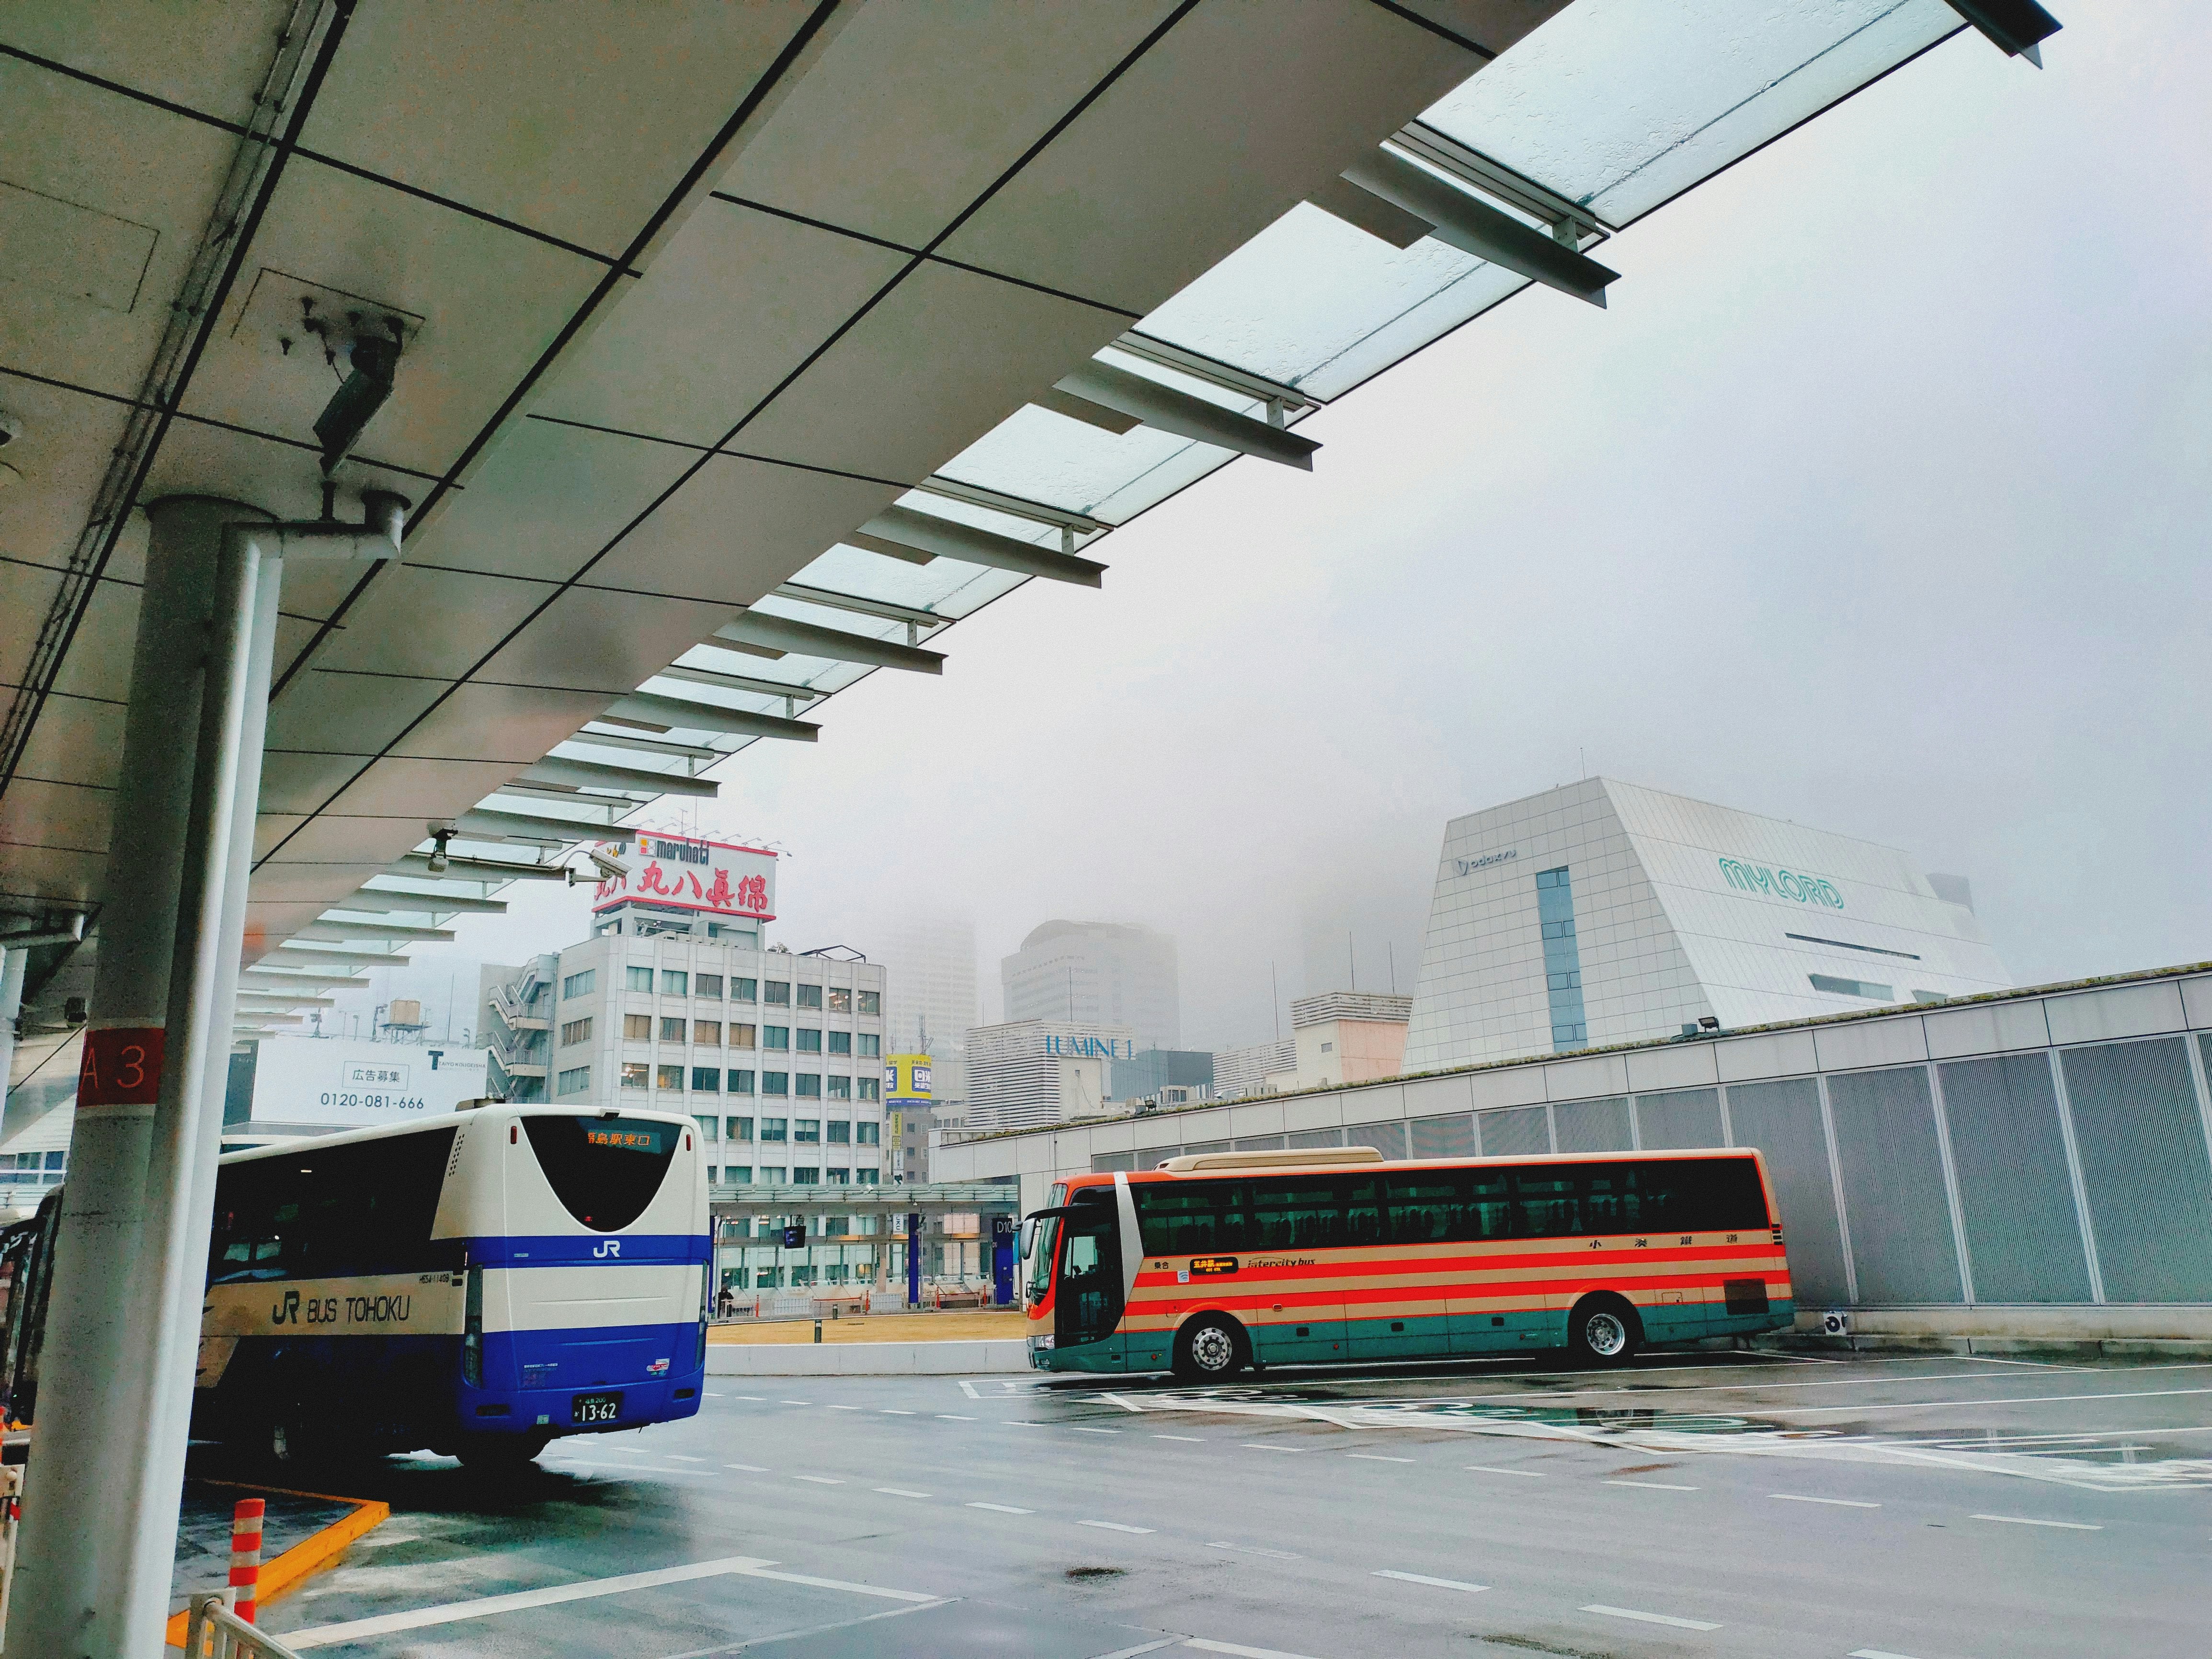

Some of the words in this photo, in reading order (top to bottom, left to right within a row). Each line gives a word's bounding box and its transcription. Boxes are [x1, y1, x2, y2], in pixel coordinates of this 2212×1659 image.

[657, 838, 709, 865] maruhati
[1719, 858, 1844, 909] MYLORD
[1046, 1034, 1120, 1058] LUMINE
[352, 1069, 400, 1083] 広告募集
[320, 1093, 424, 1109] 0120-081-666
[997, 1221, 1013, 1234] D10
[593, 1240, 621, 1258] JR
[272, 1291, 300, 1325] JR
[307, 1298, 337, 1323] BUS
[346, 1295, 410, 1323] TOHOKU
[582, 1403, 616, 1421] 13-62
